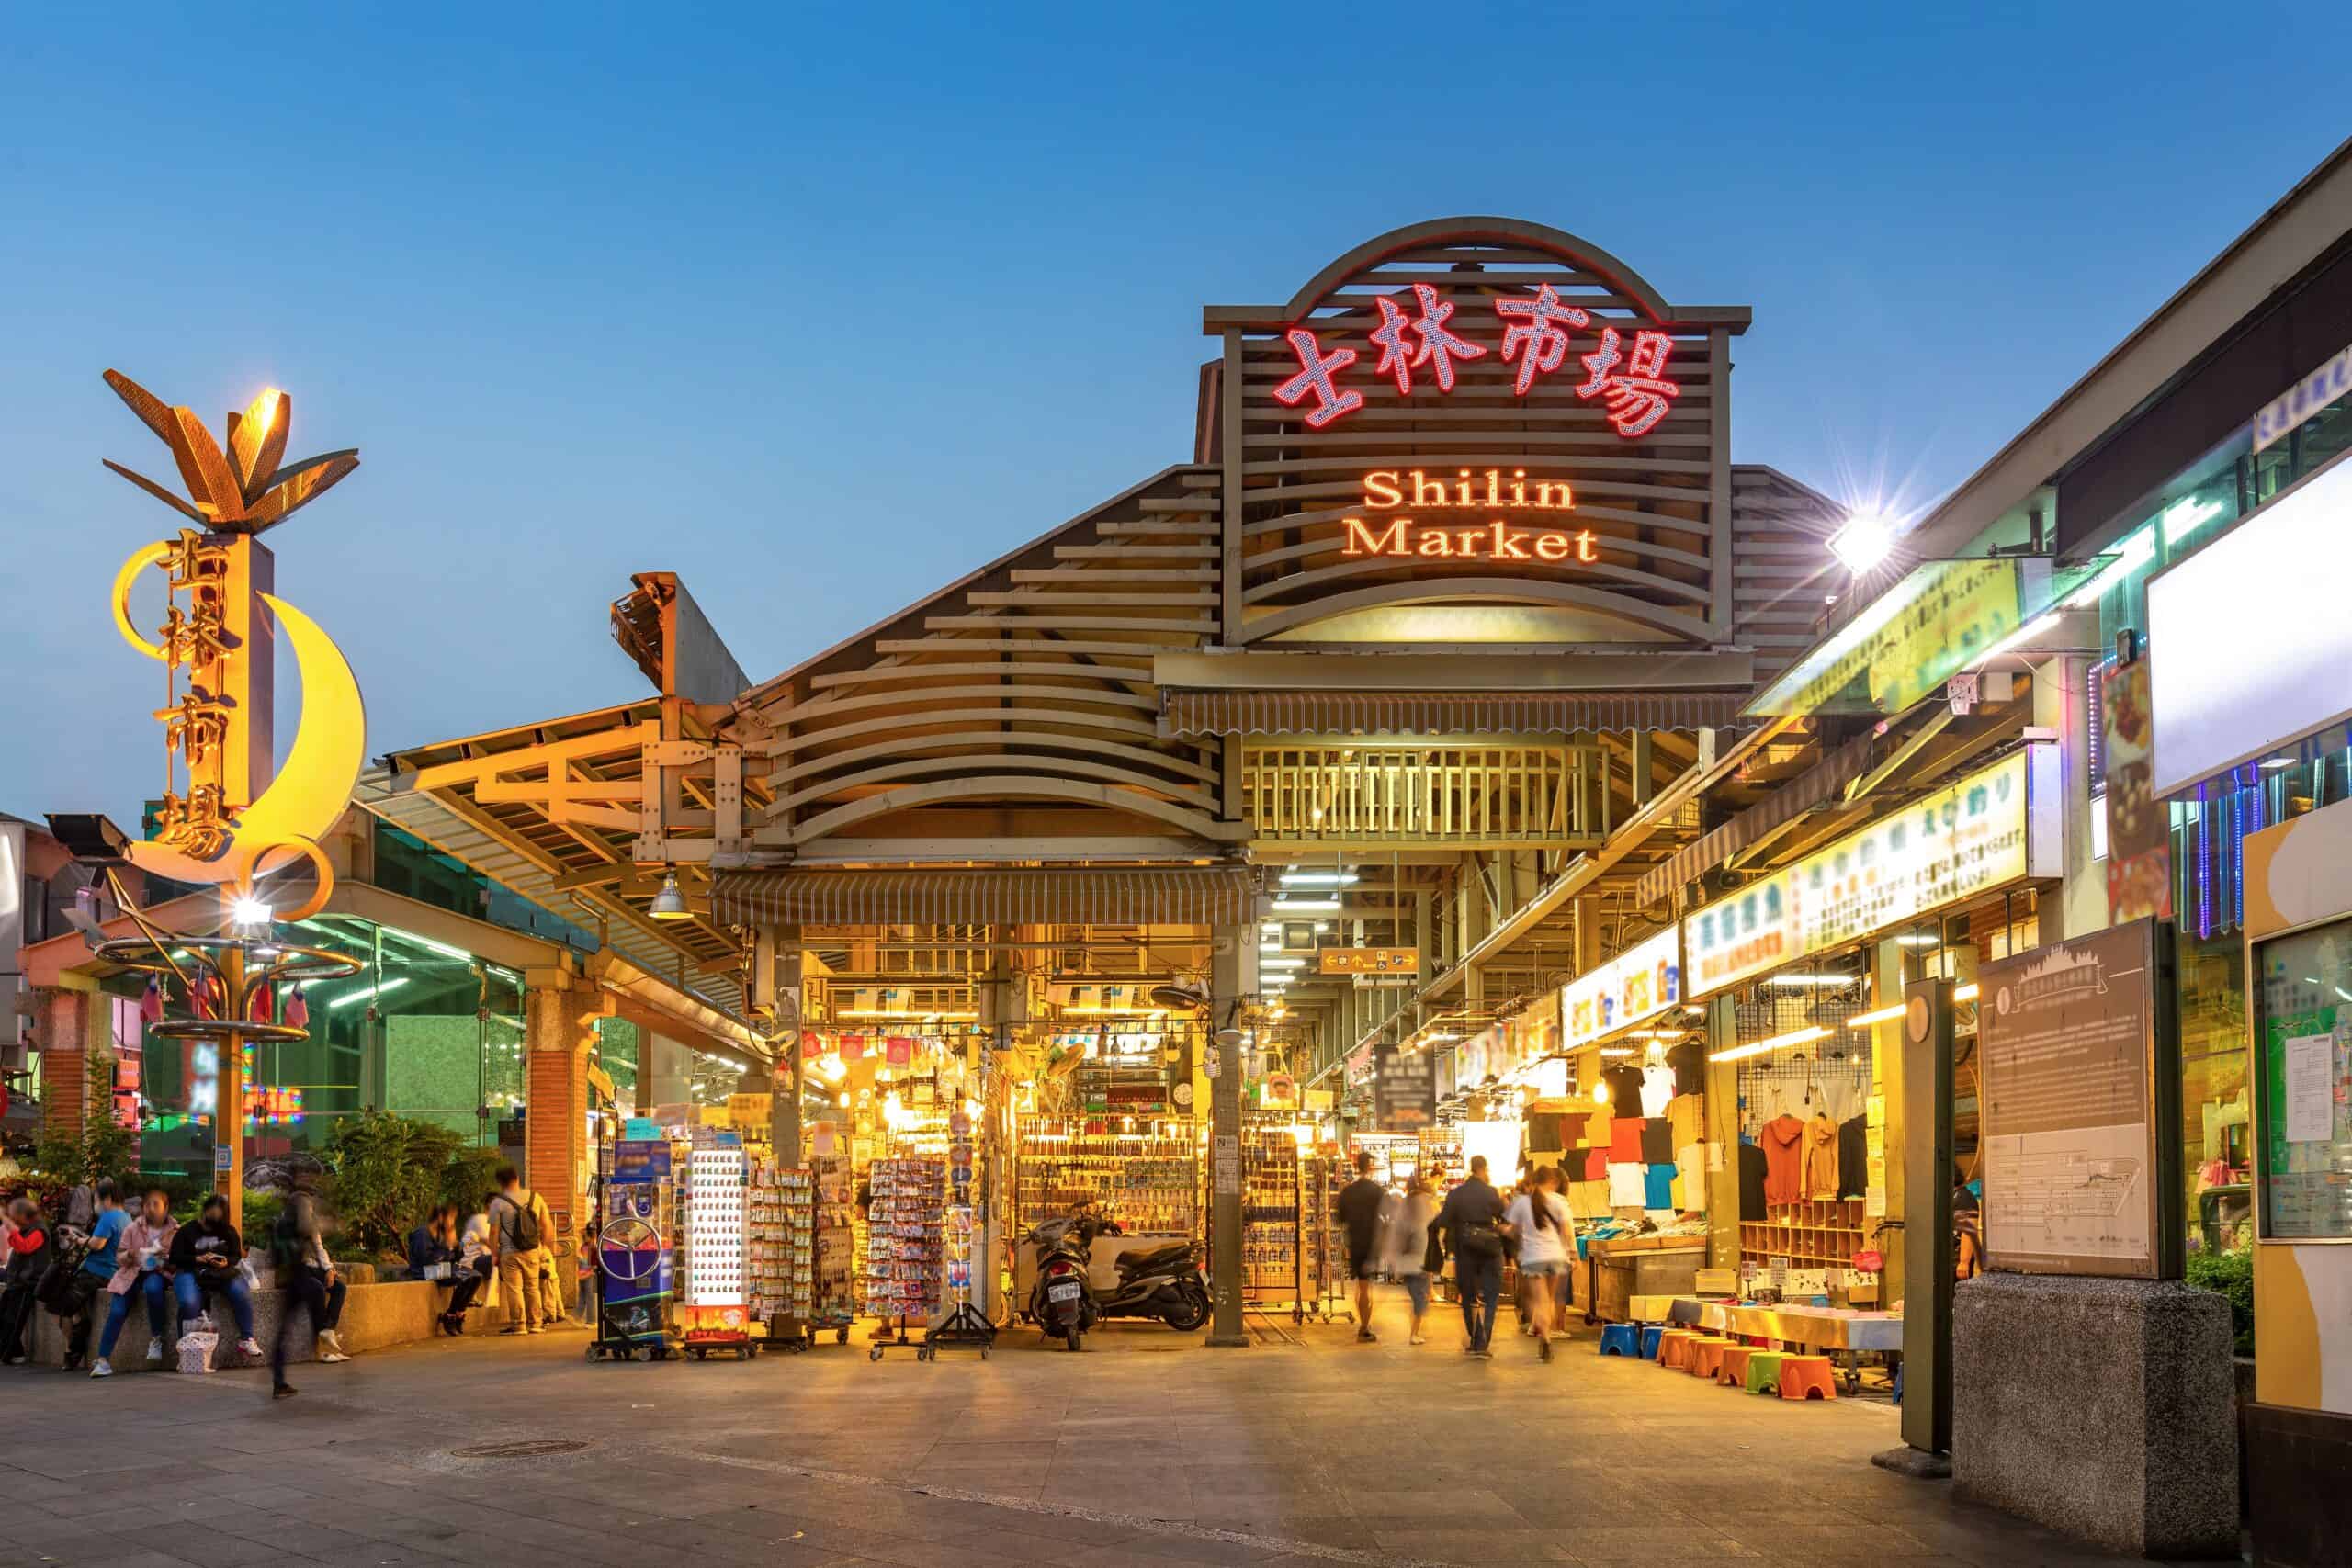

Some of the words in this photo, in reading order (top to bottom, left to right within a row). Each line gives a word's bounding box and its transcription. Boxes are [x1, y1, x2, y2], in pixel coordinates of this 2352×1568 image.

[1273, 283, 1679, 437] 士林市場
[1363, 469, 1576, 511] Shilin
[1341, 518, 1599, 563] Market
[153, 529, 233, 861] 士林市場
